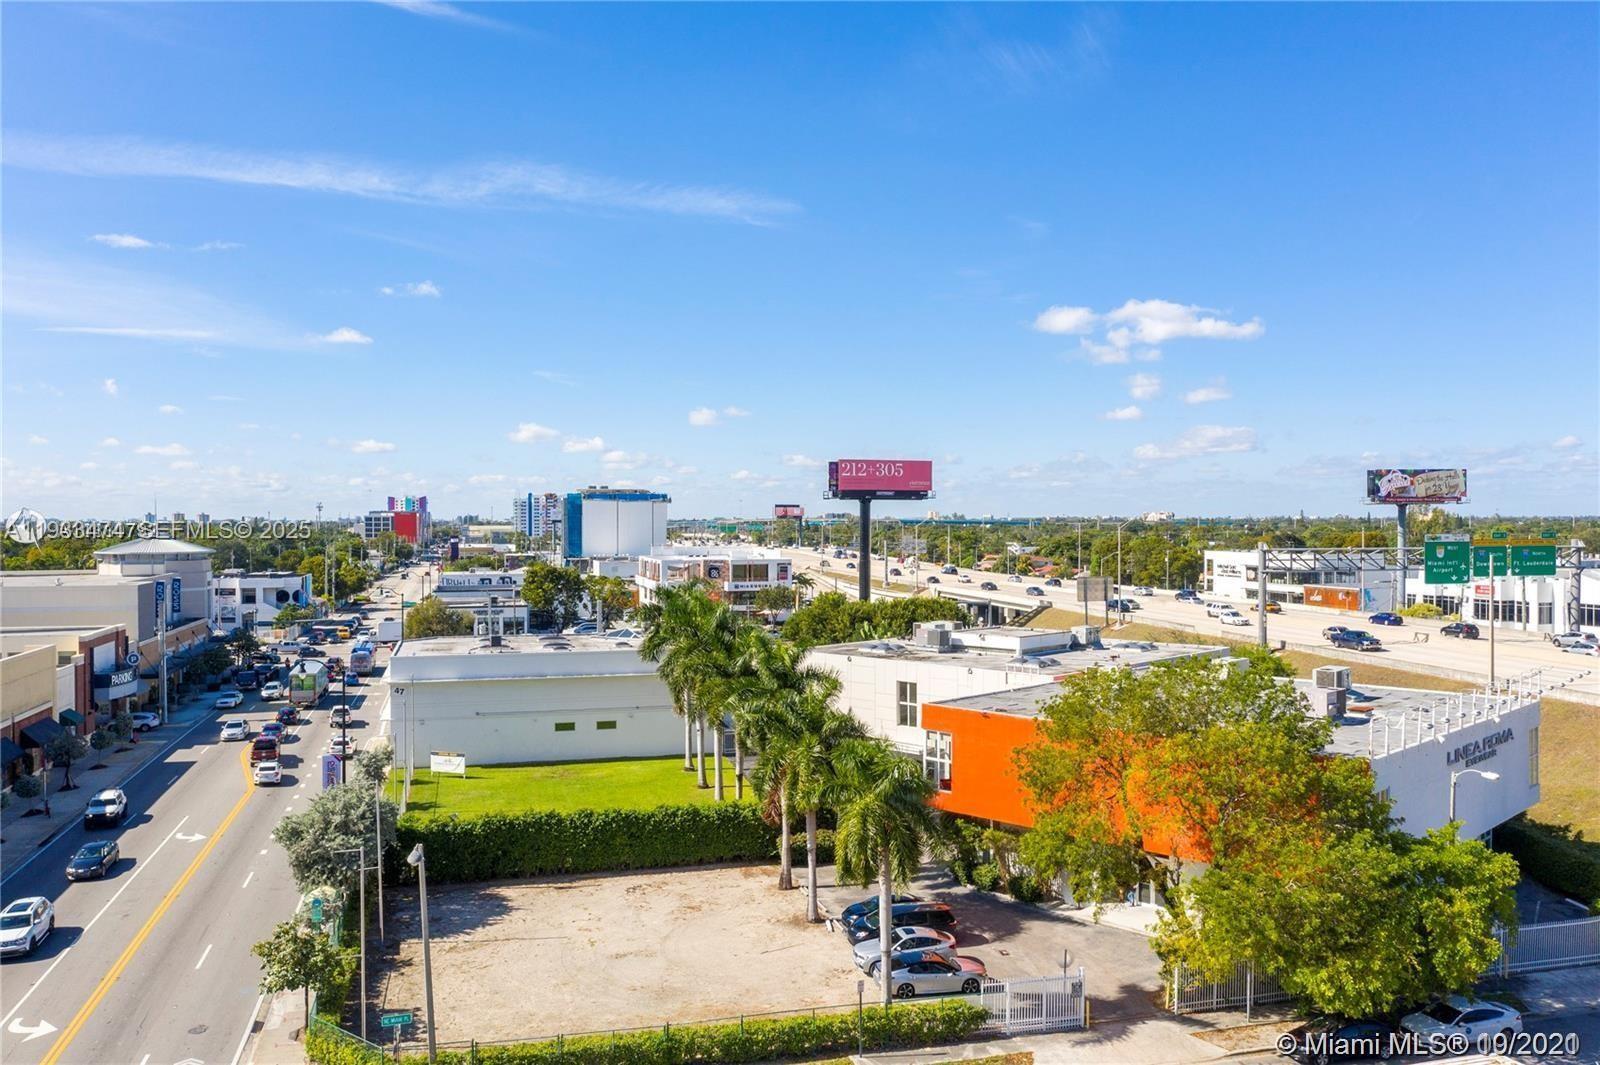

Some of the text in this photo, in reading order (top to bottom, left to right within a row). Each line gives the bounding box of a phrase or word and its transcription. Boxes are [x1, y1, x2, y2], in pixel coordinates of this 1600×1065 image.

[841, 462, 904, 477] 212+305
[111, 671, 133, 686] PARKING
[394, 687, 405, 695] 47
[1447, 728, 1515, 765] LINEA ROMA
